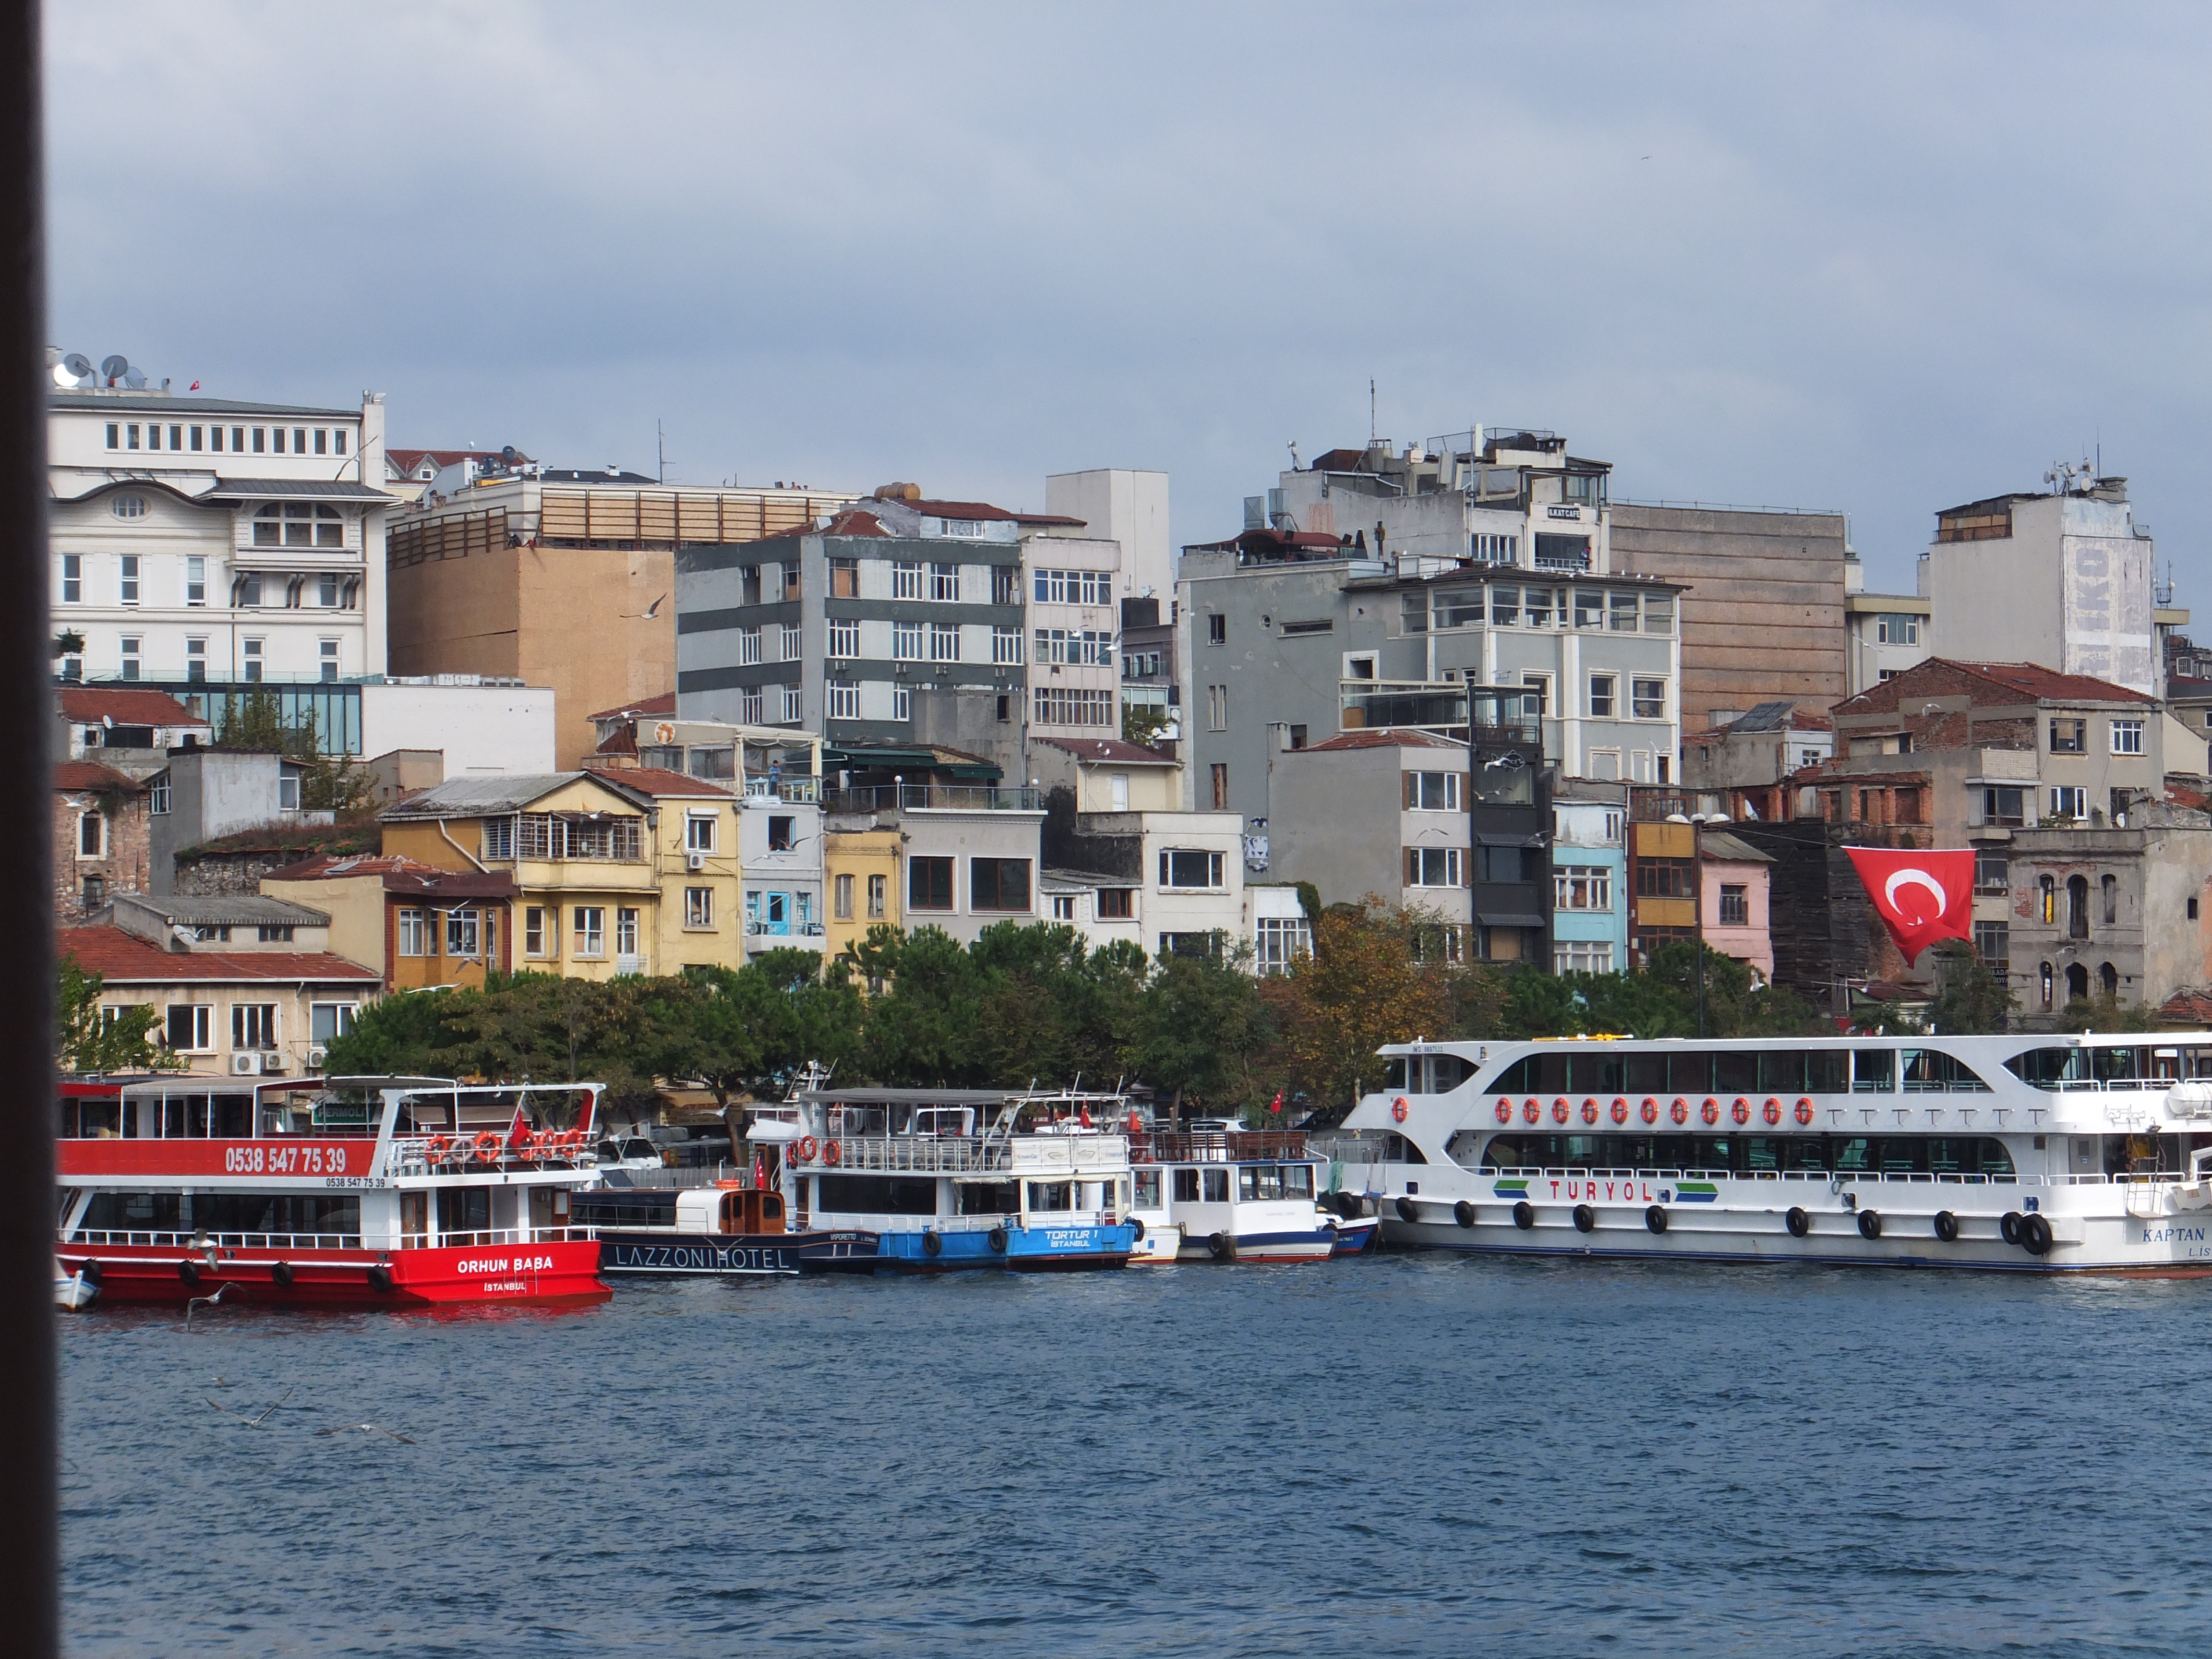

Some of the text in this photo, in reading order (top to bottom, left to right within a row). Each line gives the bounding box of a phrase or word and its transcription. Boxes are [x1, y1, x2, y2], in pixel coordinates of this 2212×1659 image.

[225, 1147, 346, 1173] 0538 547 75 39
[326, 1178, 385, 1188] 0538 547 75 39
[1550, 1181, 1652, 1202] TURYOL
[1045, 1230, 1098, 1239] TORTUR 1
[2143, 1228, 2205, 1242] KAPTAN
[2189, 1245, 2212, 1257] L.İS
[457, 1256, 553, 1273] ORHUN BABA
[484, 1283, 526, 1292] İSTANBUL
